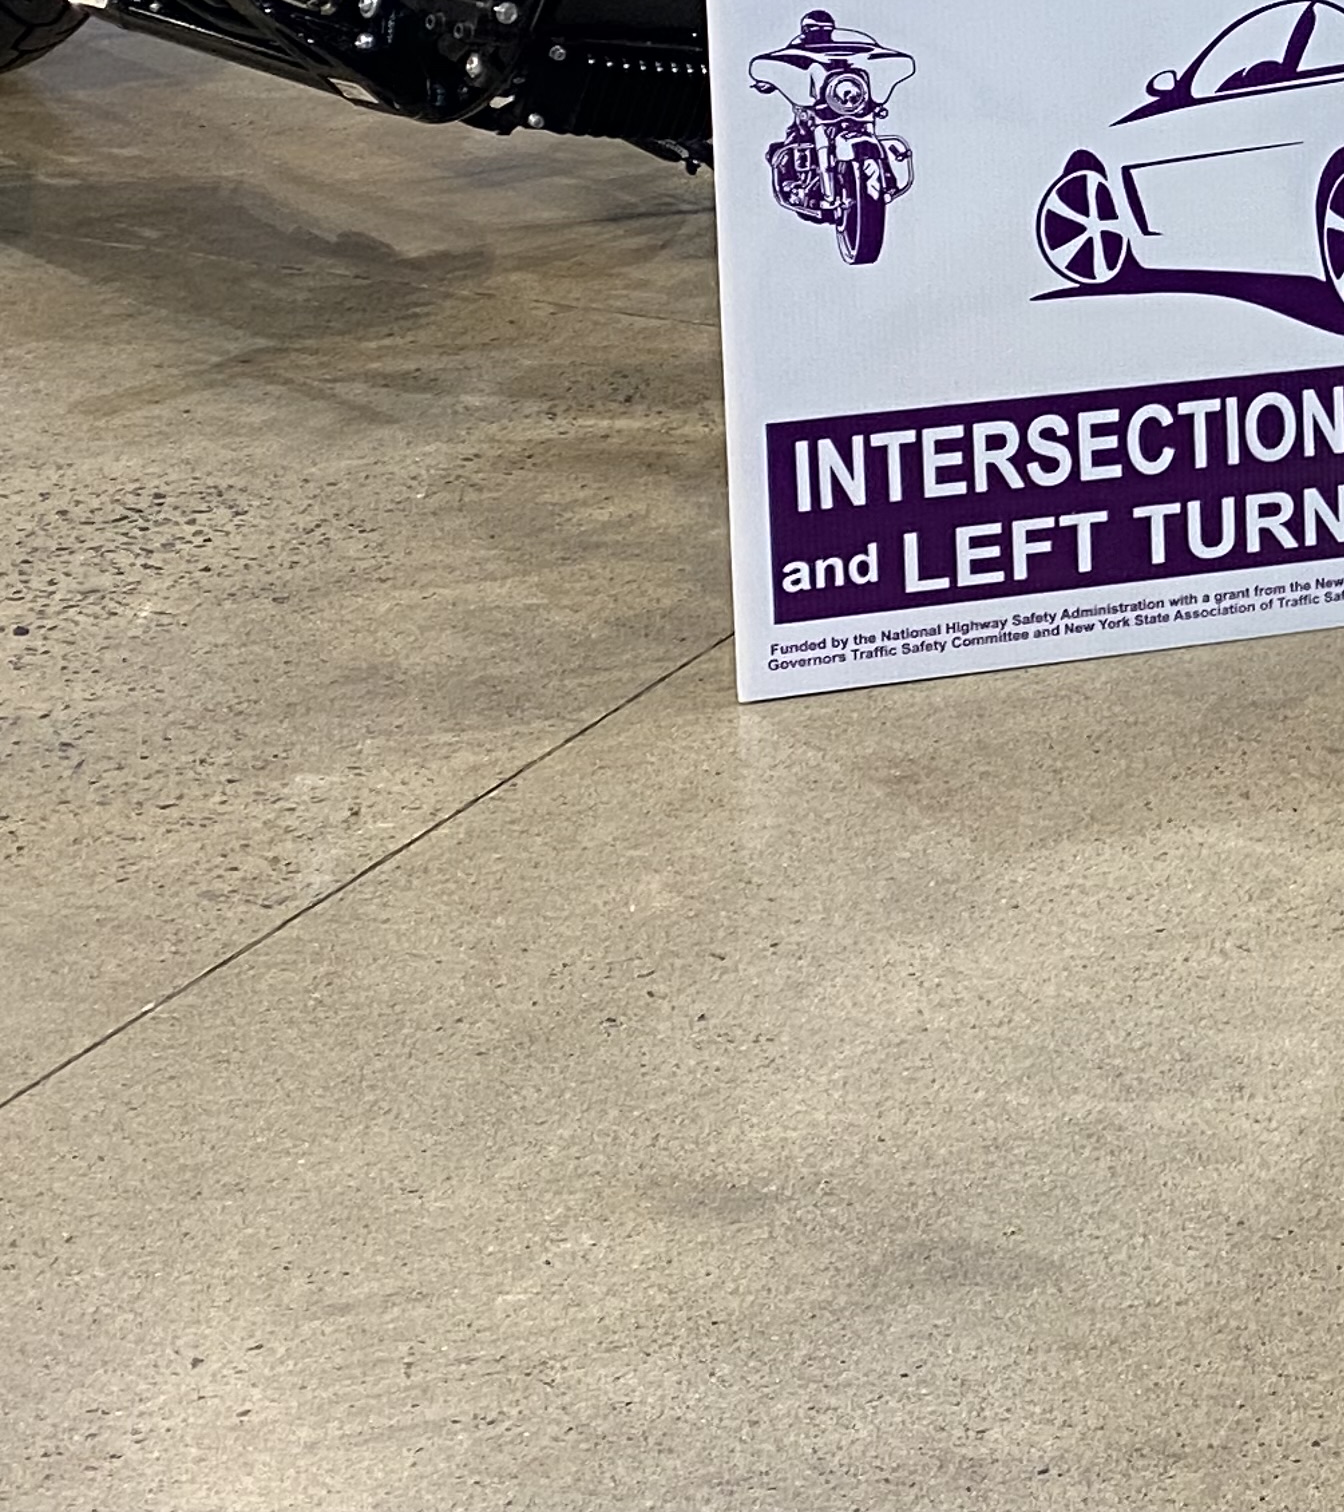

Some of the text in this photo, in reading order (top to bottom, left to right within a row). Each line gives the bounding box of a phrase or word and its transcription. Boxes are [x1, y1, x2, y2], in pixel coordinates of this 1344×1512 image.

[781, 543, 879, 595] and
[903, 510, 1108, 594] LEFT
[768, 653, 846, 671] Governors
[851, 645, 897, 661] Traffic
[901, 638, 947, 655] Safety
[951, 629, 1029, 649] Committee
[1033, 625, 1060, 639] and
[1065, 621, 1095, 635] New
[1099, 616, 1130, 630] York
[1134, 612, 1170, 626] State
[1173, 603, 1256, 622] Association
[1260, 599, 1273, 611] of
[1278, 593, 1320, 608] Traffic
[770, 638, 826, 656] Funded
[832, 635, 849, 650] by
[853, 633, 876, 646] the
[881, 626, 941, 642] National
[945, 618, 1008, 636] Highway
[1012, 611, 1057, 629] Safety
[1060, 598, 1165, 621] Administration
[1168, 593, 1198, 607] with
[1202, 594, 1210, 603] a
[1214, 587, 1251, 604] grant
[1254, 584, 1286, 597] from
[1289, 580, 1311, 593] the
[1315, 577, 1344, 590] New
